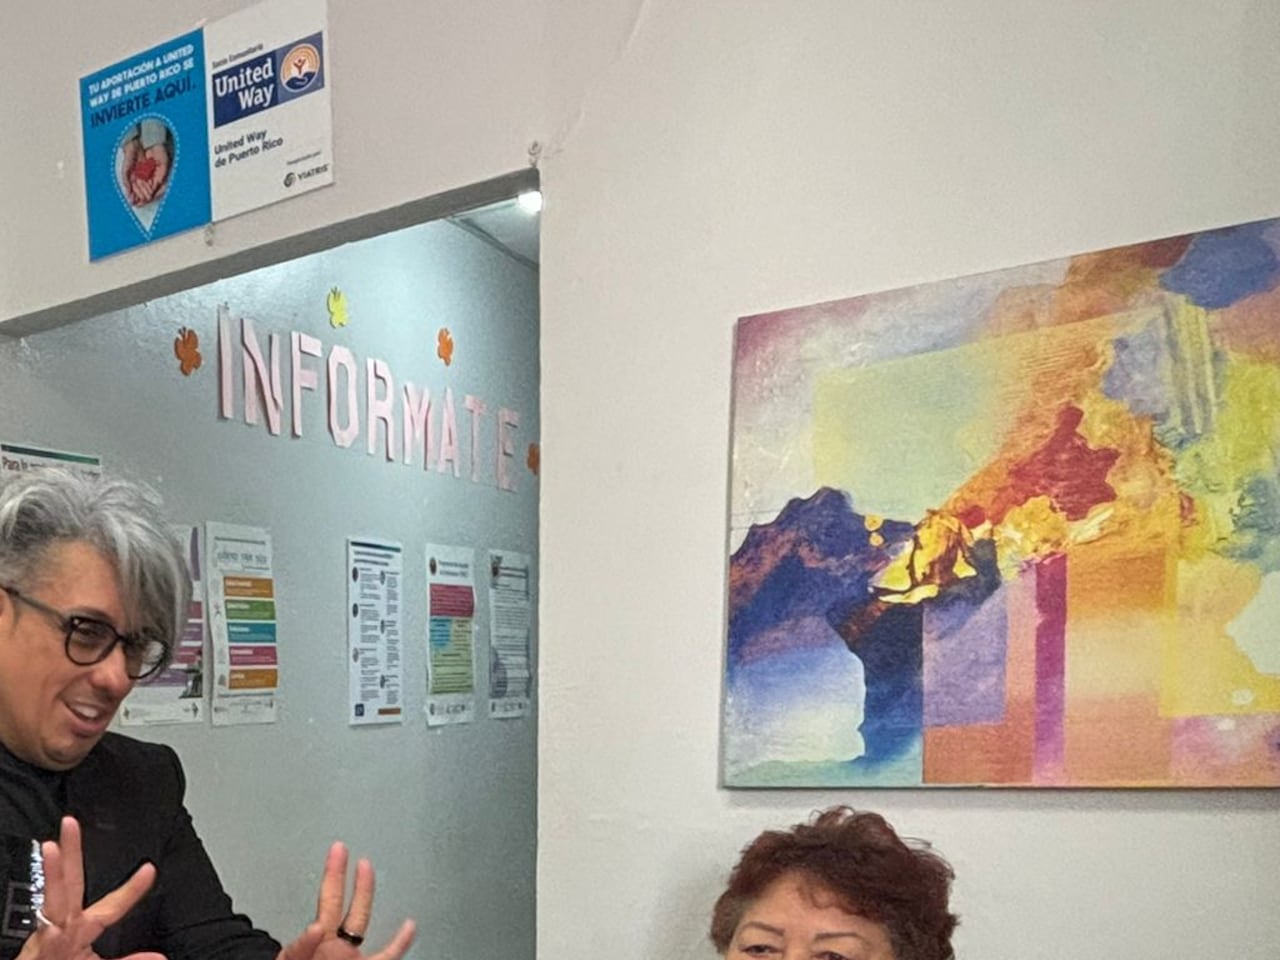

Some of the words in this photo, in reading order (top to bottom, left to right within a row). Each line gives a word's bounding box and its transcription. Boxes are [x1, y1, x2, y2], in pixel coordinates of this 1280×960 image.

[155, 57, 162, 67] A
[214, 57, 274, 97] United
[89, 93, 109, 107] WAY
[111, 86, 122, 99] DE
[124, 72, 158, 94] PUERTO
[159, 63, 181, 80] RICO
[237, 83, 274, 110] Way
[90, 92, 150, 128] INVIERTE
[214, 136, 244, 155] United
[246, 129, 267, 146] Way
[214, 157, 227, 168] de
[228, 147, 260, 165] Puerto
[261, 137, 284, 152] Rico
[218, 303, 520, 493] INFORMATE
